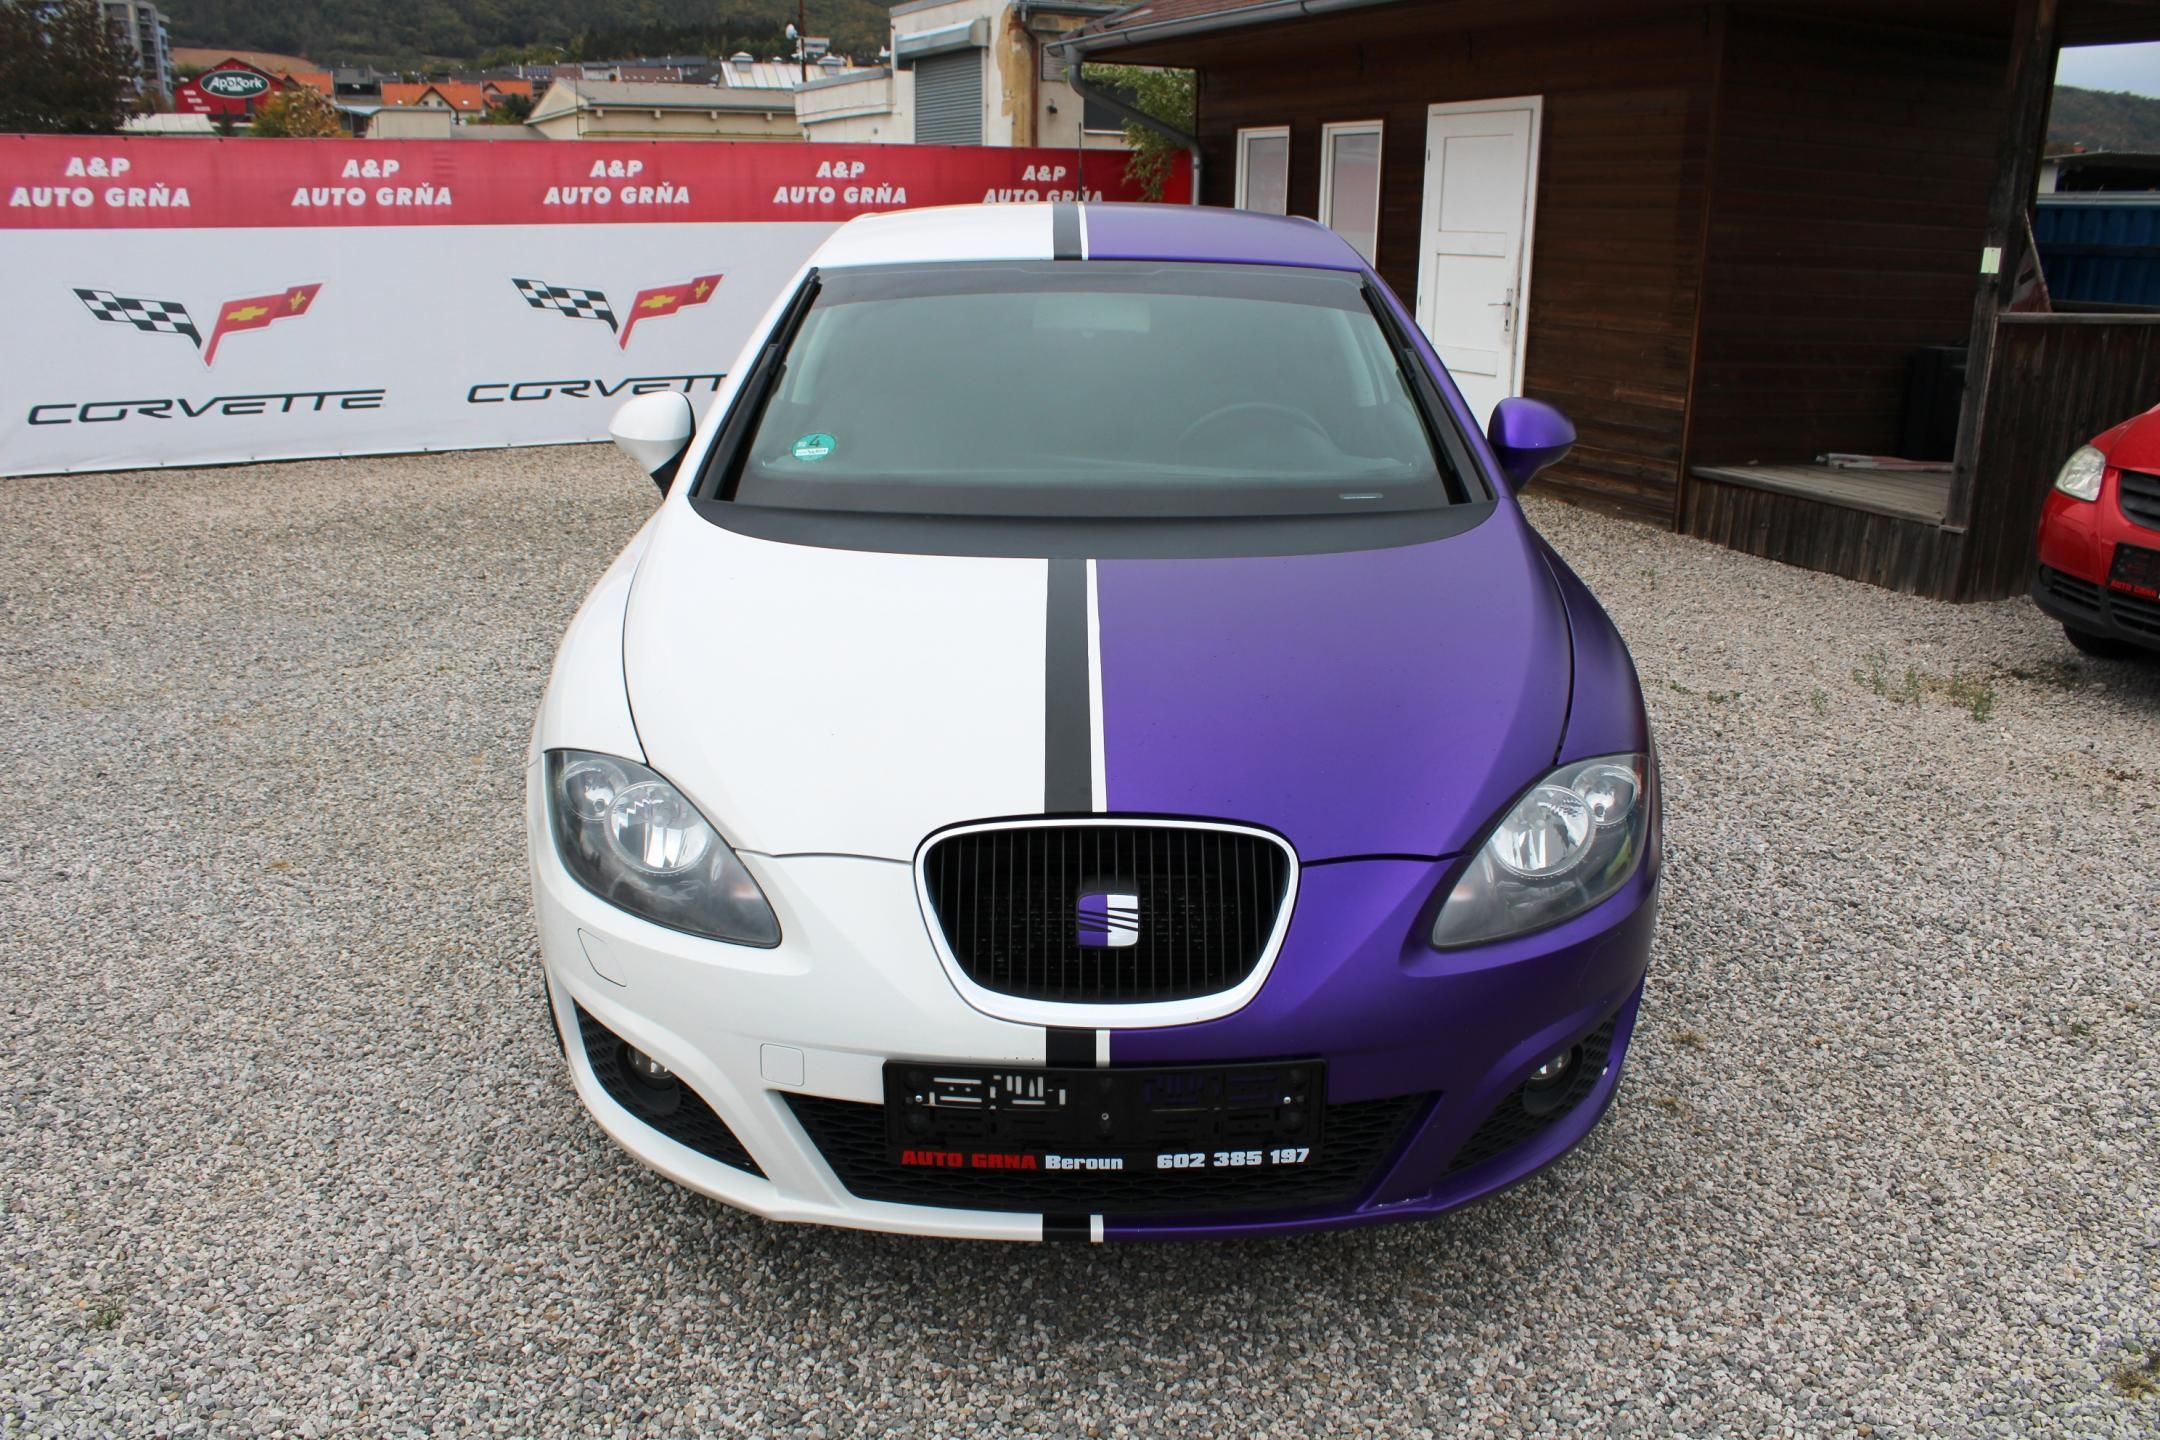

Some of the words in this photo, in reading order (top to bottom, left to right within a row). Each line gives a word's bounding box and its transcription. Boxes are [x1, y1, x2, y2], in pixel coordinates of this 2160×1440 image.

[64, 156, 131, 177] A&P
[341, 159, 400, 178] A&P
[589, 160, 643, 177] A&P
[816, 161, 865, 178] A&P
[1022, 165, 1066, 181] A&P
[9, 187, 94, 207] AUTO
[104, 182, 191, 207] GRŇA
[291, 187, 366, 206] AUTO
[375, 182, 452, 206] GRŇA
[543, 186, 612, 205] AUTO
[620, 181, 690, 205] GRŇA
[773, 186, 836, 204] AUTO
[843, 182, 907, 204] GRŇA
[982, 188, 1039, 203] AUTO
[467, 374, 728, 403] CORVETT
[28, 389, 386, 425] CORVETTE
[901, 1150, 963, 1168] AUTO
[1045, 1155, 1123, 1170] Beroun
[1157, 1153, 1206, 1169] 602
[1213, 1151, 1263, 1167] 385
[1270, 1148, 1310, 1164] 197
